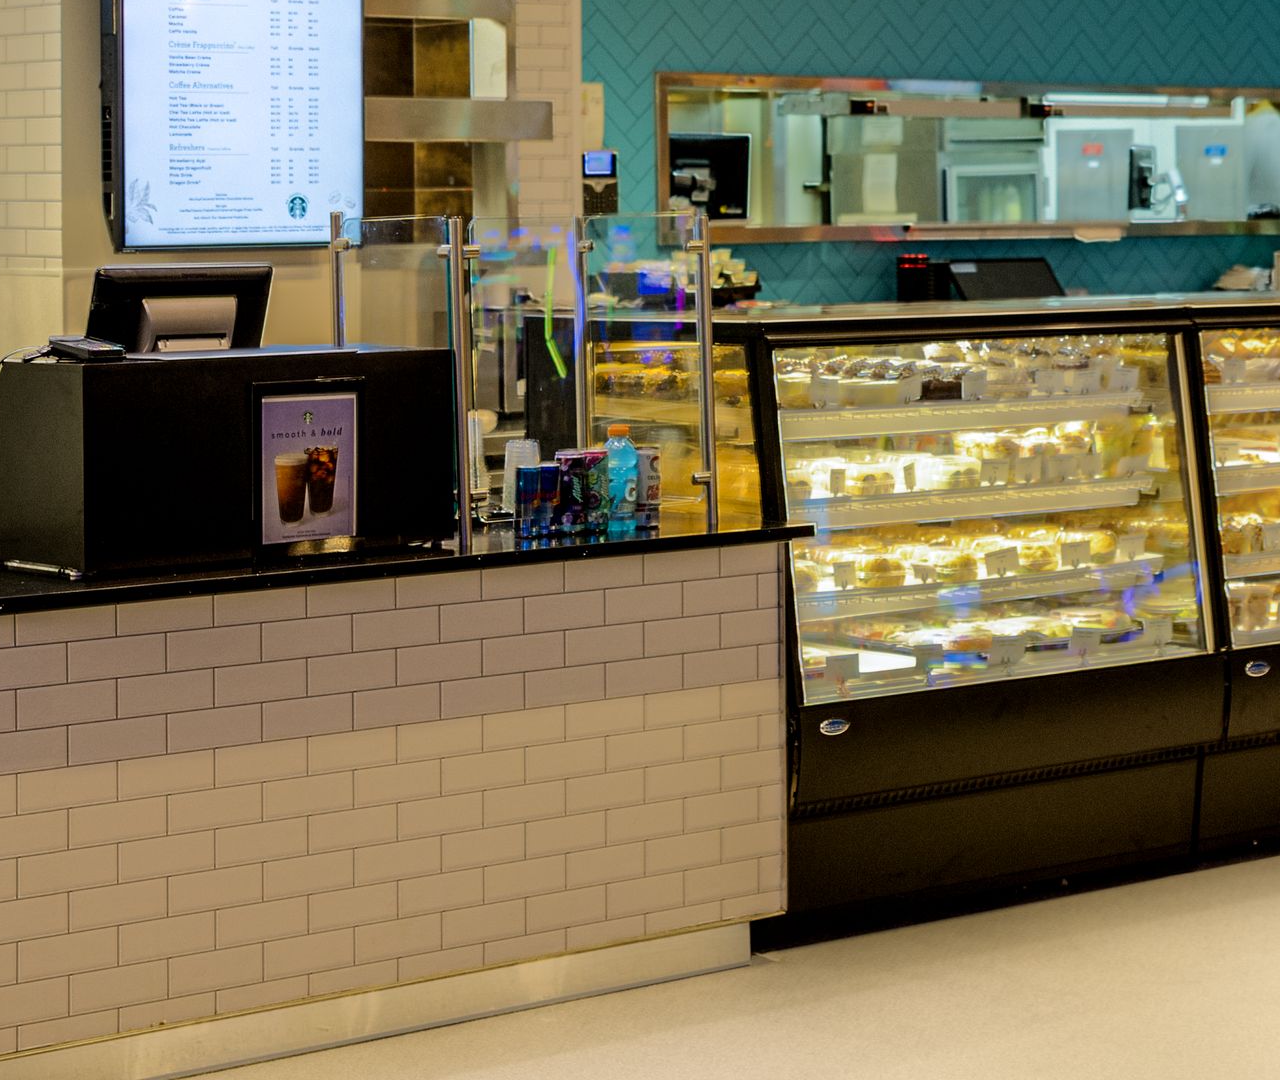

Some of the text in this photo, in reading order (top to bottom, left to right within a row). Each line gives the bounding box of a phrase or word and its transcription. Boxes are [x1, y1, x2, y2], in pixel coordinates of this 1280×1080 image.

[169, 81, 234, 90] Coffee Alternatives
[271, 427, 343, 440] smooth & bold
